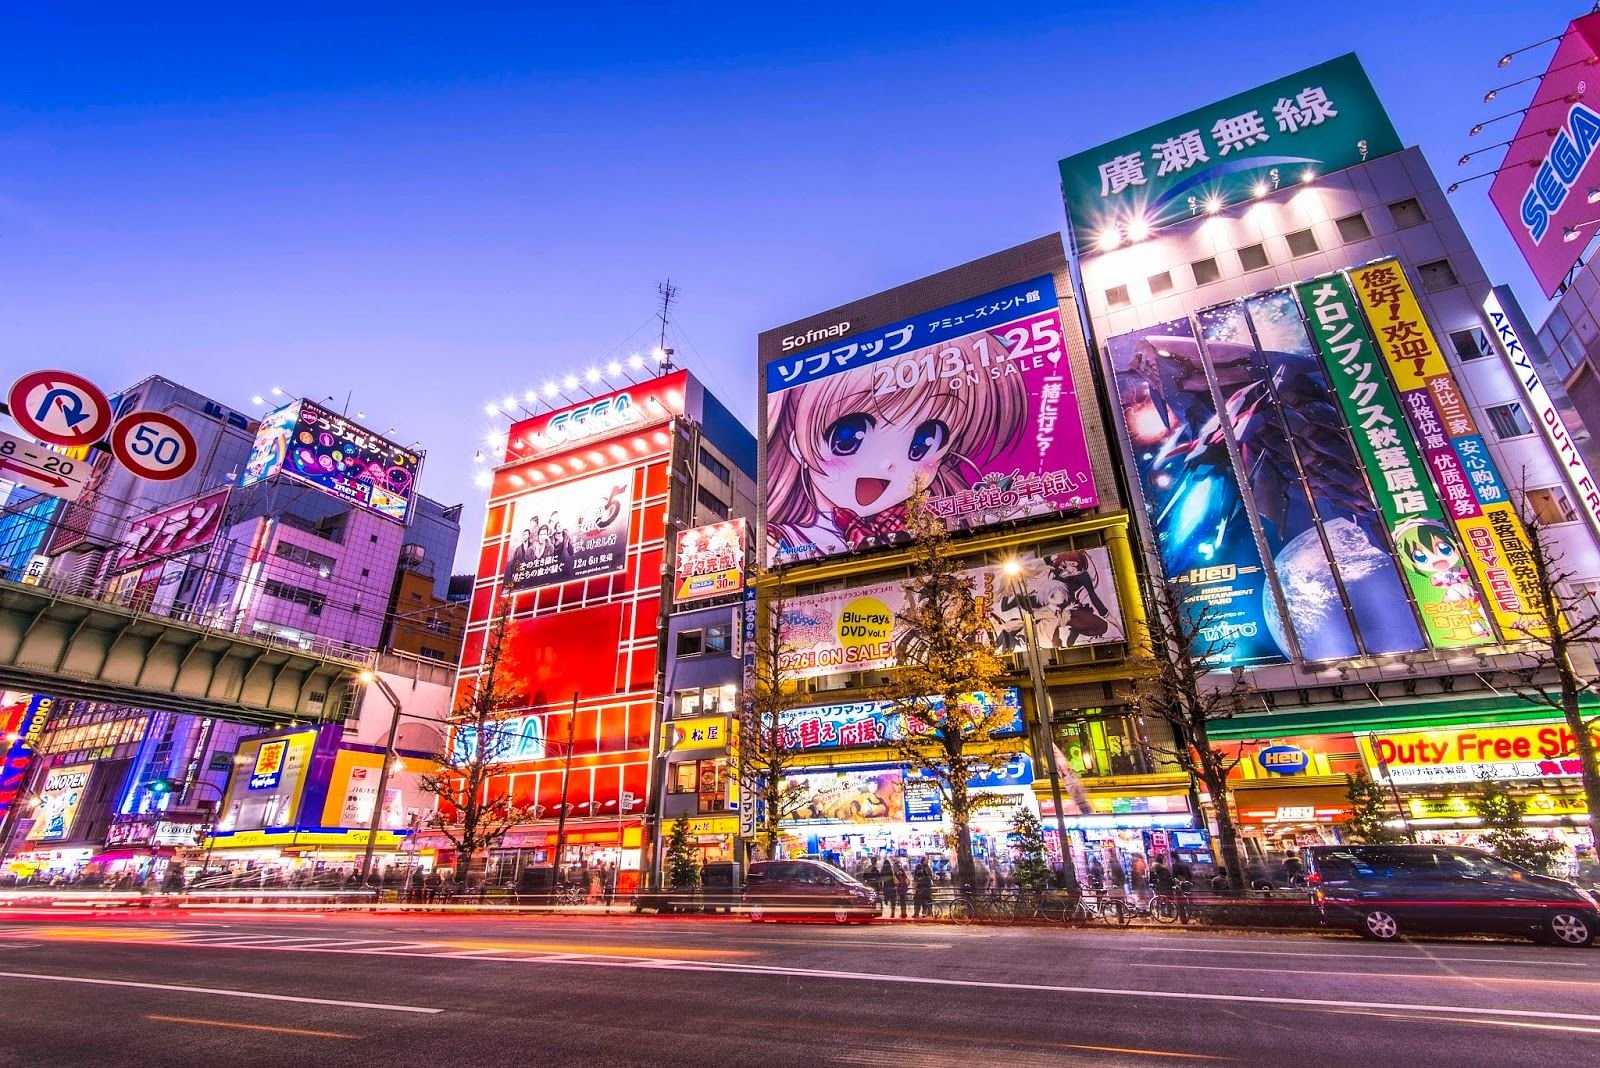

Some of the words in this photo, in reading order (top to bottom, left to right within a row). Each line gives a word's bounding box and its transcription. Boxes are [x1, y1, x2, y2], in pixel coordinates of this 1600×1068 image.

[1098, 85, 1339, 199] 廣瀬無線
[1520, 102, 1600, 247] SEGA
[778, 324, 914, 382] ソフマップ
[928, 289, 1041, 333] アミューズメント館
[782, 321, 851, 351] Sofmap
[872, 318, 1061, 397] 2013.1.25
[949, 373, 980, 391] ON
[991, 354, 1043, 381] SALE
[1490, 311, 1531, 370] AKKY
[1543, 407, 1581, 468] DUTY
[1312, 283, 1428, 514] メロンブックス秋葉原店
[1407, 391, 1448, 450] 价格优惠
[1430, 376, 1472, 435] 货比三家
[44, 456, 74, 475] 20
[131, 425, 180, 465] 50
[1458, 439, 1502, 501] 安心购物
[1434, 453, 1476, 516] 优质服务
[1190, 563, 1237, 585] Hey
[1468, 528, 1500, 567] DUTY
[1486, 569, 1522, 612] FREE
[818, 648, 843, 666] ON
[841, 626, 867, 637] DVD
[24, 698, 51, 749] ONODE
[692, 726, 718, 741] 松屋
[821, 702, 876, 716] ソフマップ
[1265, 751, 1303, 766] Hey
[1377, 736, 1448, 764] Duty
[1457, 733, 1531, 762] Free
